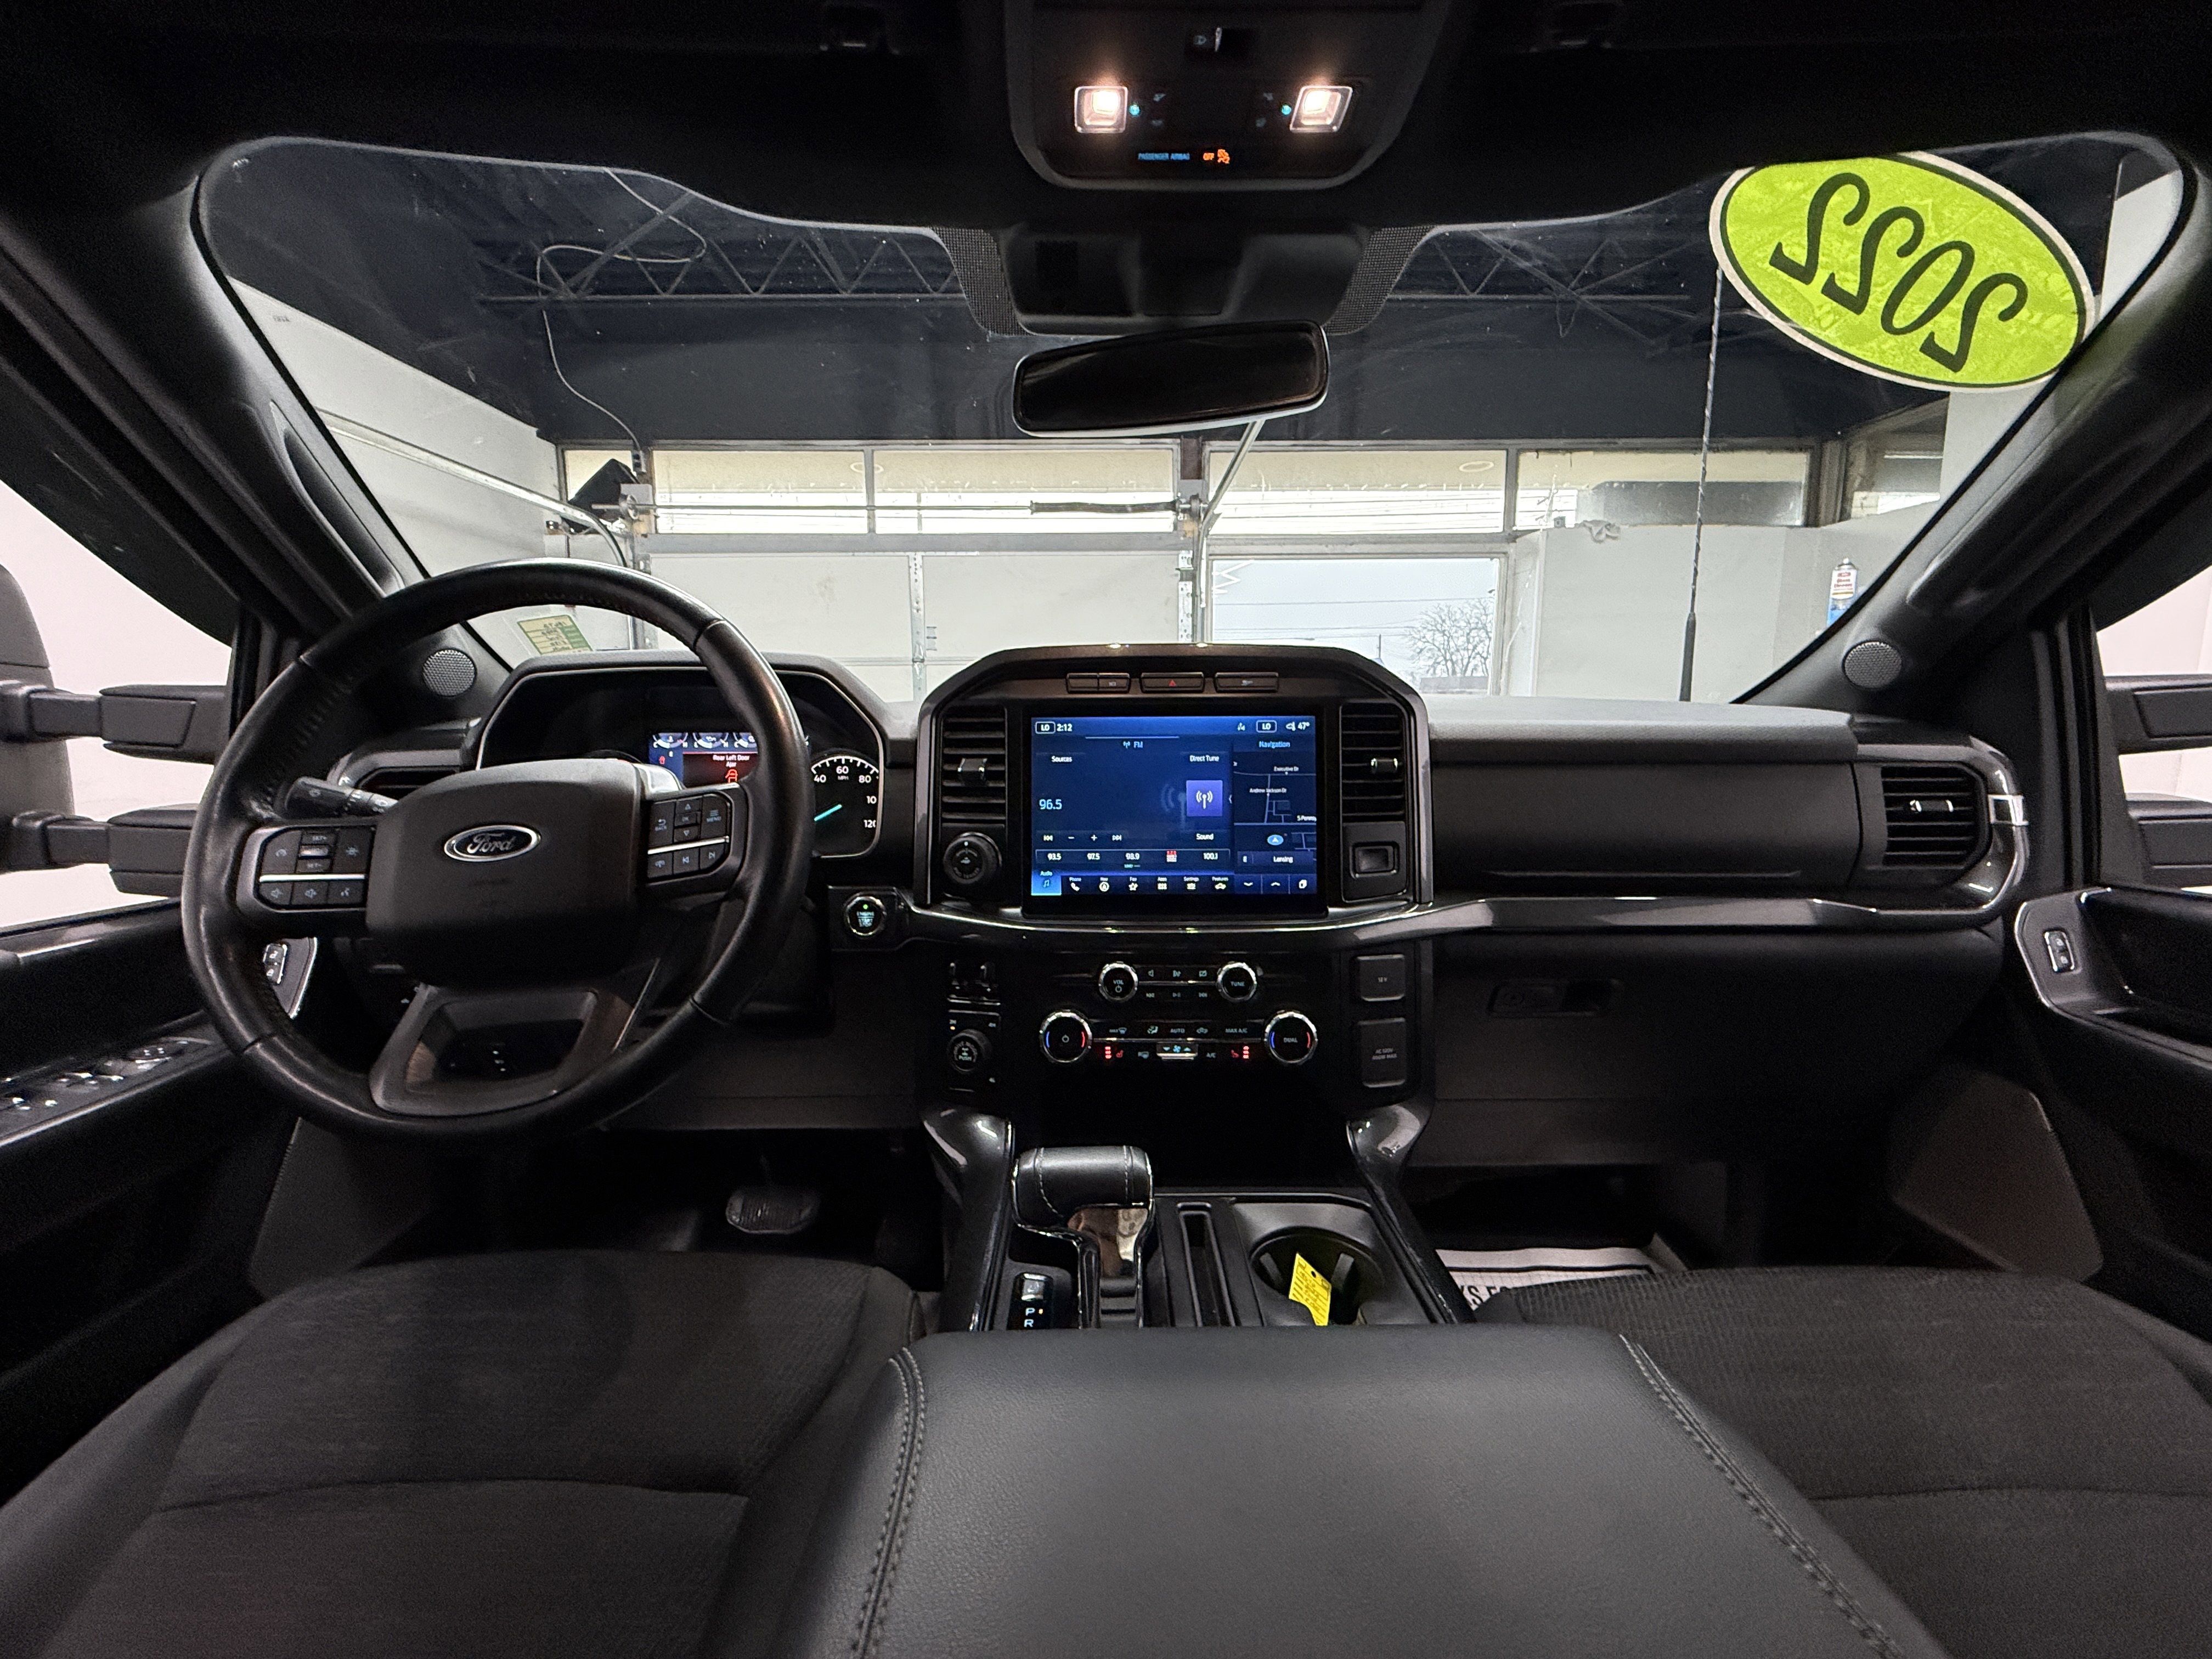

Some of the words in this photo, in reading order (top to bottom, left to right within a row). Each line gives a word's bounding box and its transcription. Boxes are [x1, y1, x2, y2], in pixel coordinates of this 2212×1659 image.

[836, 765, 849, 775] 60
[814, 774, 827, 783] 40
[858, 775, 872, 784] 80
[866, 795, 877, 804] 10
[1039, 799, 1063, 810] 96.5
[466, 832, 517, 854] Ford
[1203, 852, 1218, 860] 100.1
[1025, 1307, 1036, 1316] P
[1024, 1318, 1034, 1328] R
